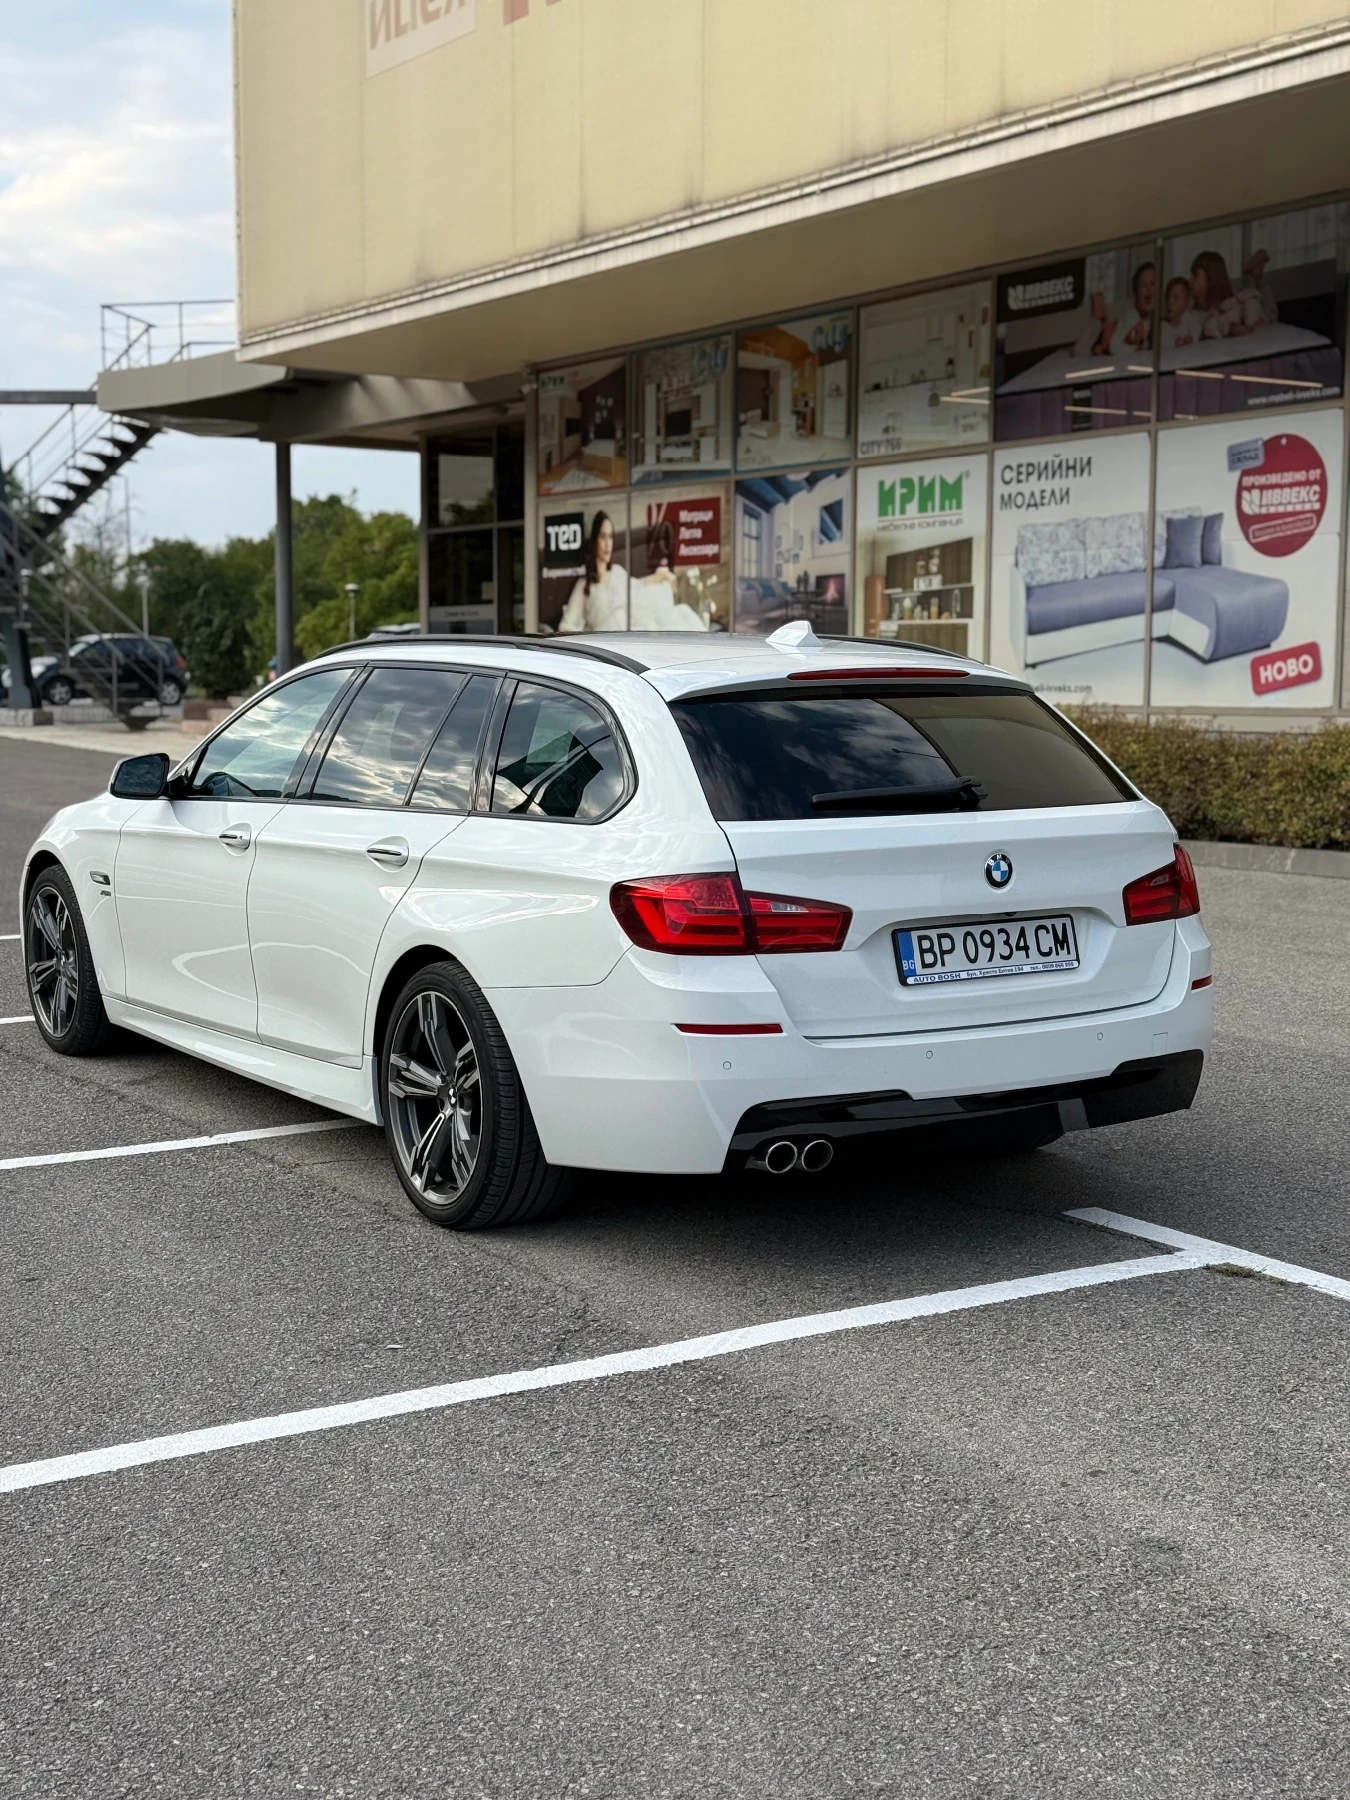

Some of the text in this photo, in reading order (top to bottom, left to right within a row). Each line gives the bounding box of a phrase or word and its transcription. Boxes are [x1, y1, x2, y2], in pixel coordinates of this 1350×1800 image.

[1000, 453, 1093, 485] СЕРИЙНИ
[1241, 469, 1322, 487] ПРОИЗВЕДЕНО ОТ
[877, 471, 964, 517] ИРИМ
[1000, 487, 1071, 511] МОДЕЛИ
[1261, 485, 1321, 506] ИВВЕКС
[1259, 654, 1314, 685] НОВО
[917, 922, 1071, 970] BP 0934 CM
[902, 959, 915, 971] BG
[913, 973, 961, 983] AUTO BOSH
